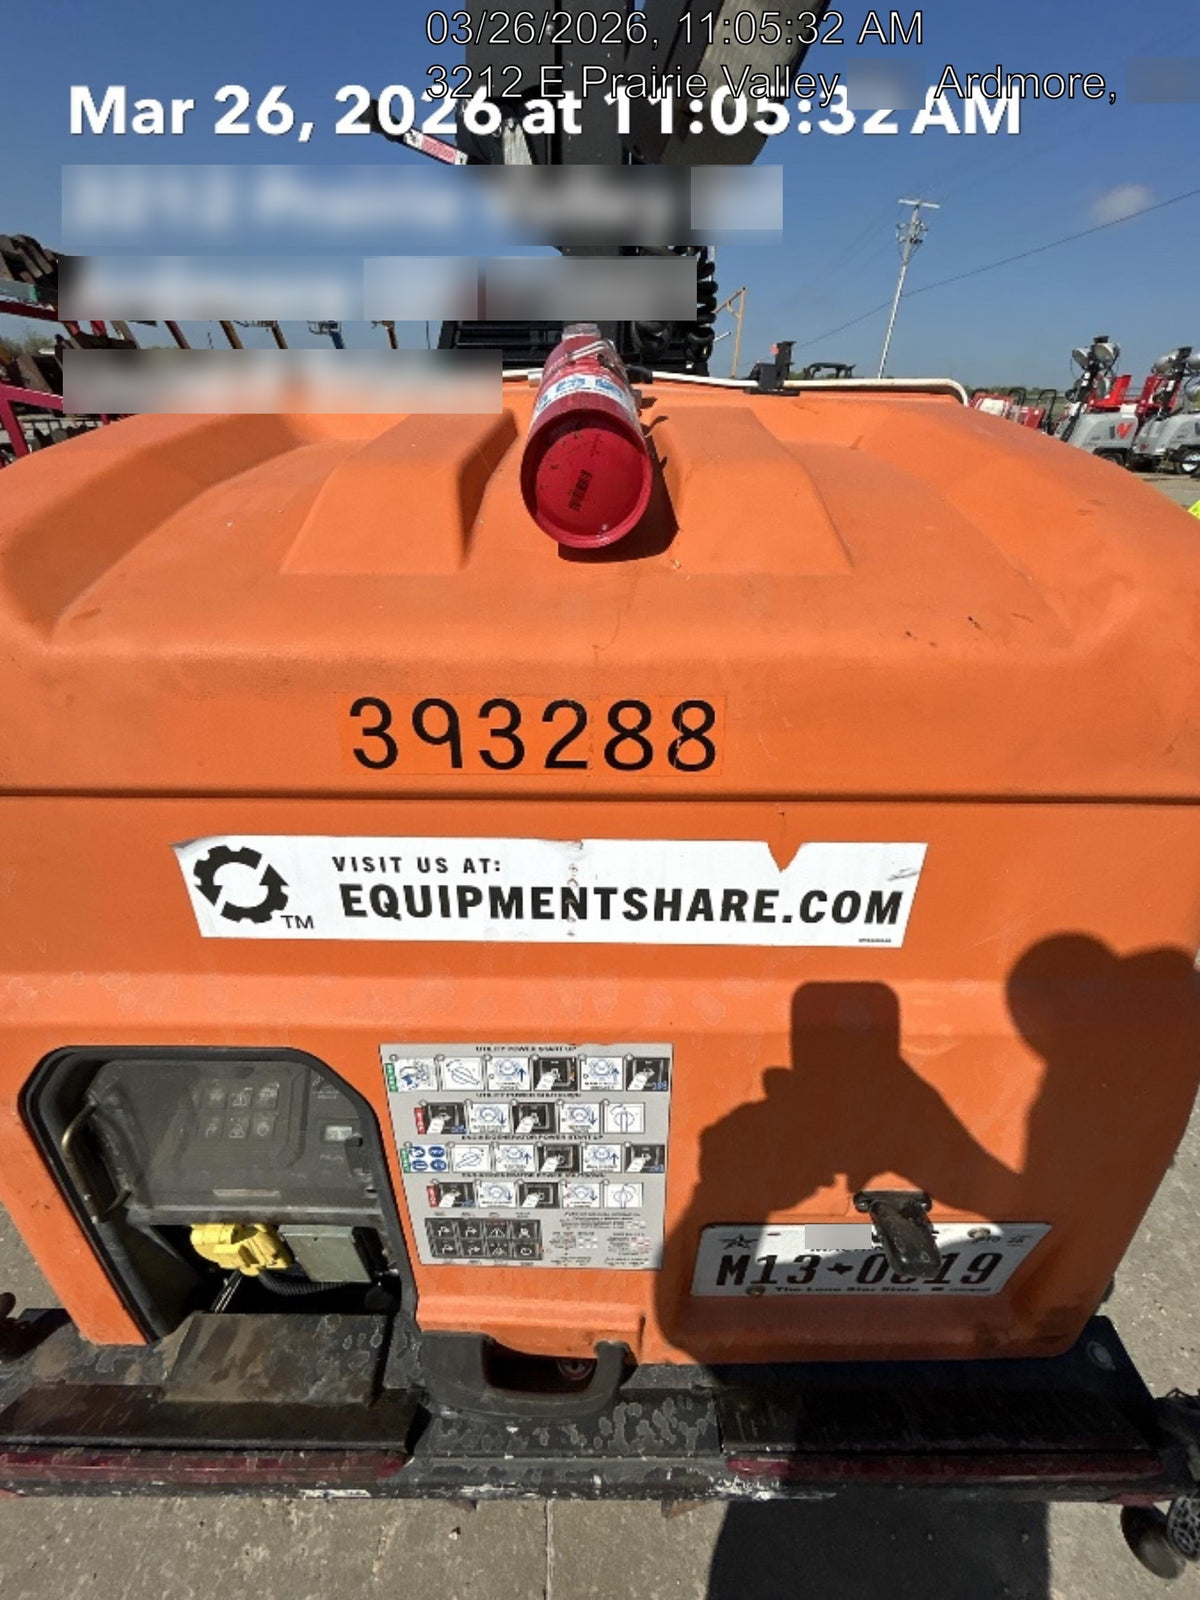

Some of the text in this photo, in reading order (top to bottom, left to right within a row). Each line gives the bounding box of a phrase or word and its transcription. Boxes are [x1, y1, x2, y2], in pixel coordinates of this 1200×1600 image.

[349, 696, 716, 773] 393288
[331, 856, 502, 874] VISIT US AT:
[339, 883, 904, 926] EQUIPMENTSHARE.COM
[280, 914, 316, 930] TM
[716, 1252, 1004, 1286] M13 019
